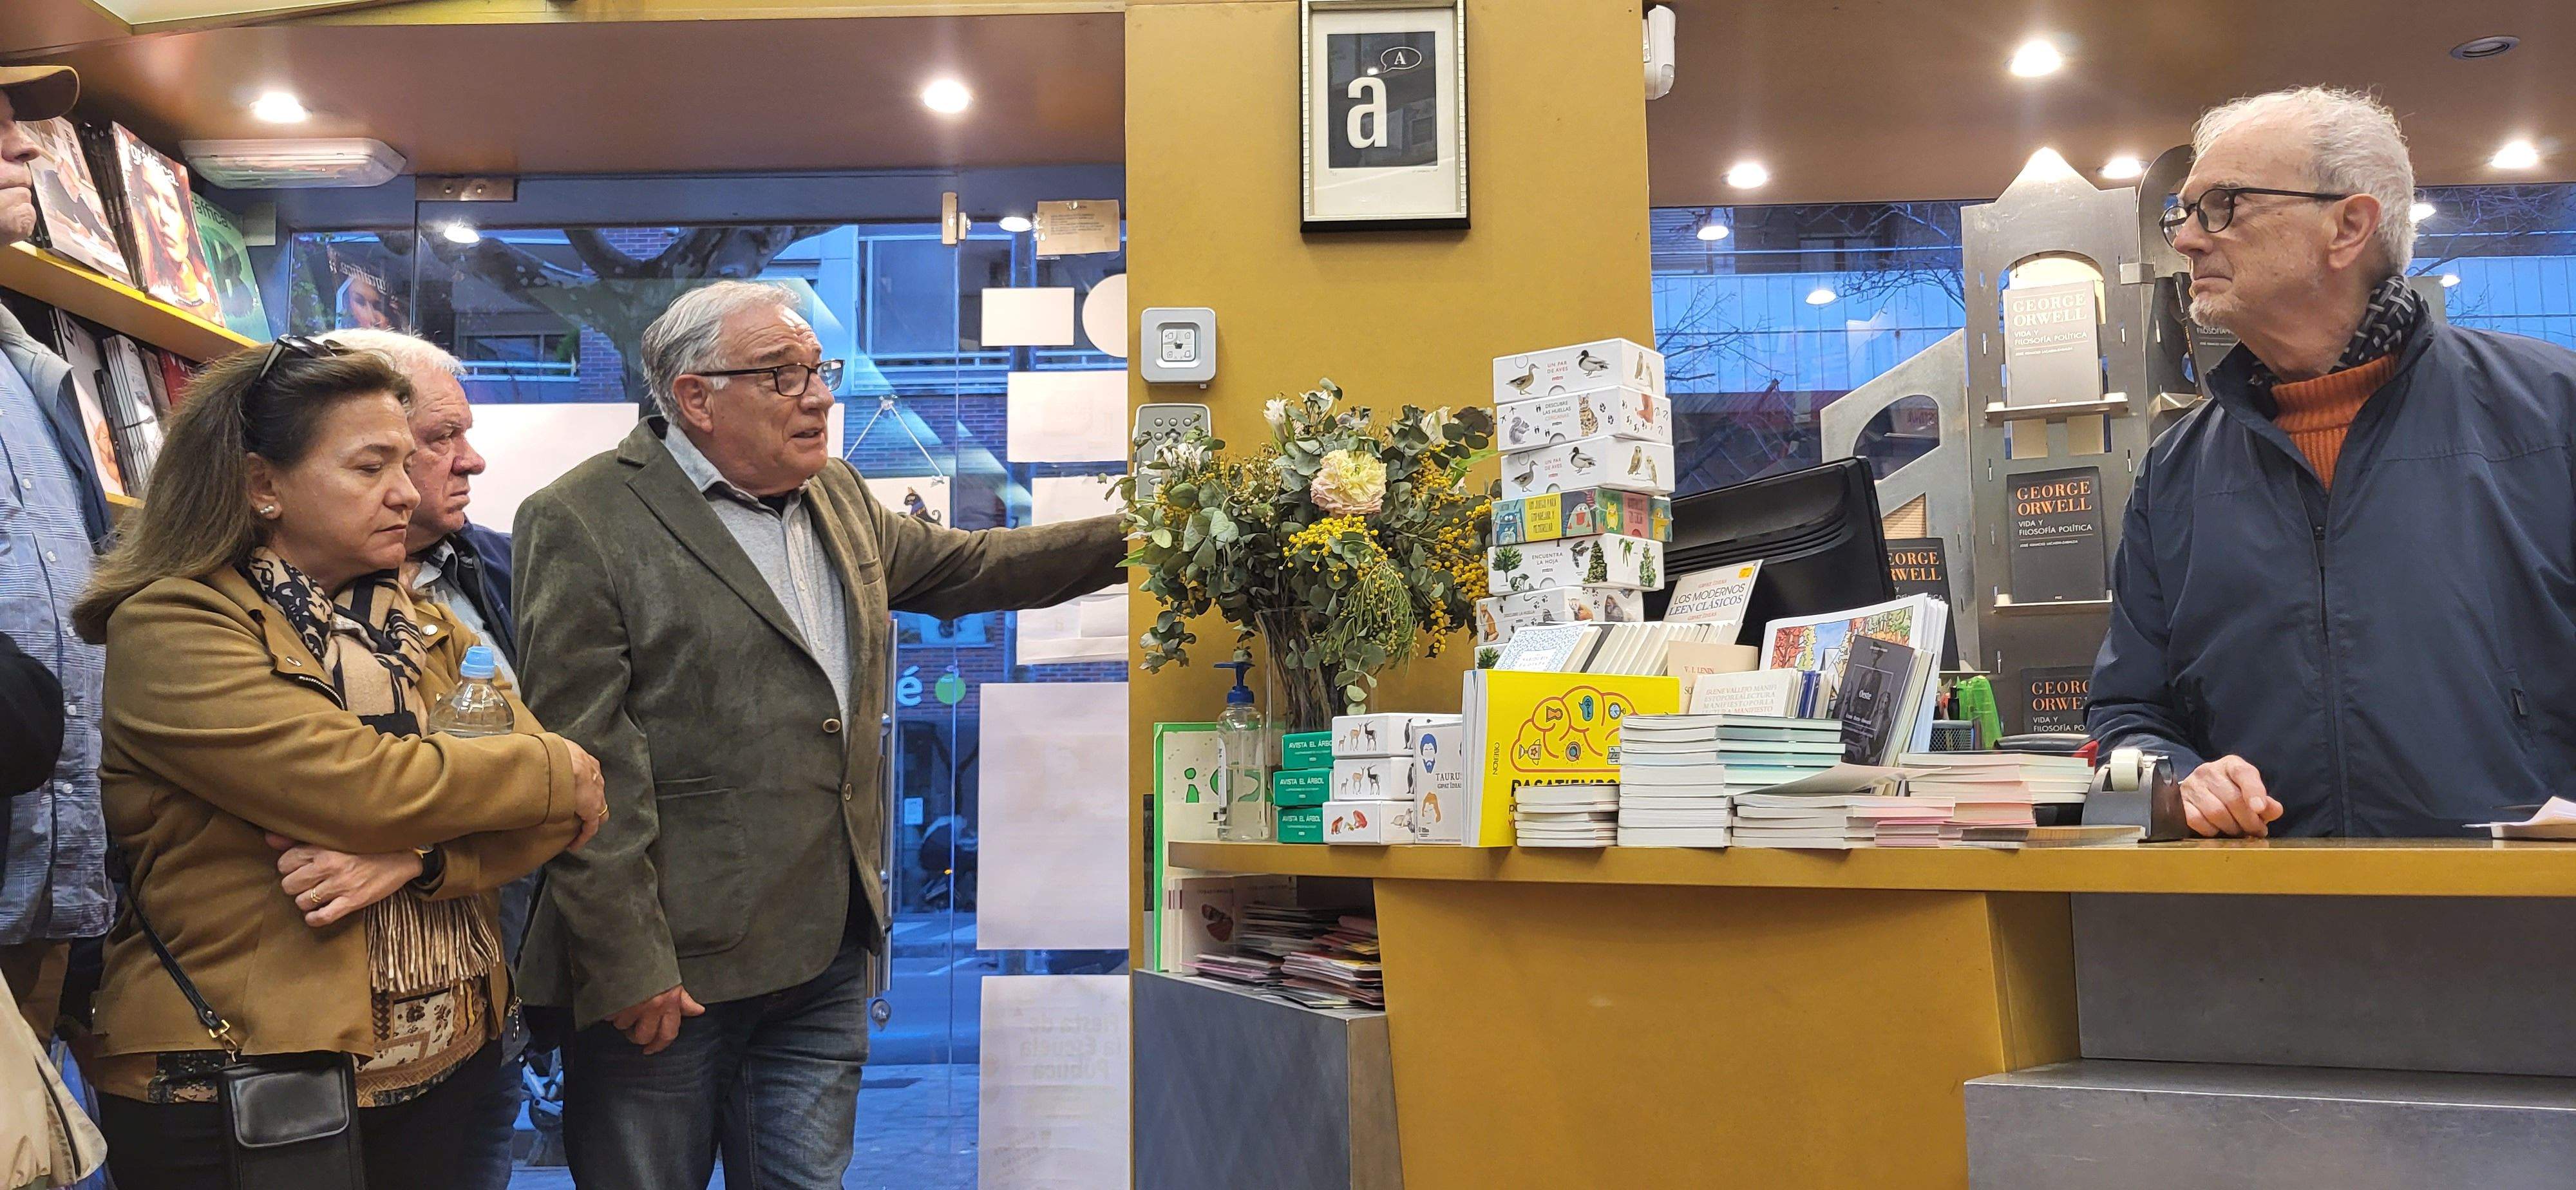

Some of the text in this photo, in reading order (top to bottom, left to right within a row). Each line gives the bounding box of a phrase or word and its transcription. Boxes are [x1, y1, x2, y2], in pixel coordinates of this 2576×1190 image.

[1394, 51, 1407, 65] A
[1347, 77, 1387, 149] a
[2012, 293, 2087, 313] GEORGE
[2013, 308, 2087, 327] ORWELL
[2014, 330, 2087, 346] FILOSOFÍA POLÍTICA
[2016, 481, 2091, 500] GEORGE
[2017, 496, 2092, 516] ORWELL
[2018, 524, 2093, 536] FILOSOFÍA POLÍTICA
[1887, 551, 1939, 565] EORGE
[1890, 567, 1942, 581] RWELL
[1674, 583, 1746, 605] LOS MODERNOS
[1669, 594, 1743, 616] LEEN CLÁSICOS
[2031, 679, 2089, 695] GEORG
[1859, 690, 1872, 700] Oeste
[2032, 696, 2087, 711] ORWE
[2033, 724, 2071, 732] FILOSOFÍA
[1318, 739, 1332, 747] ÁRBO
[1307, 777, 1324, 785] ÁRBOL
[1305, 814, 1321, 822] ÁRBOL
